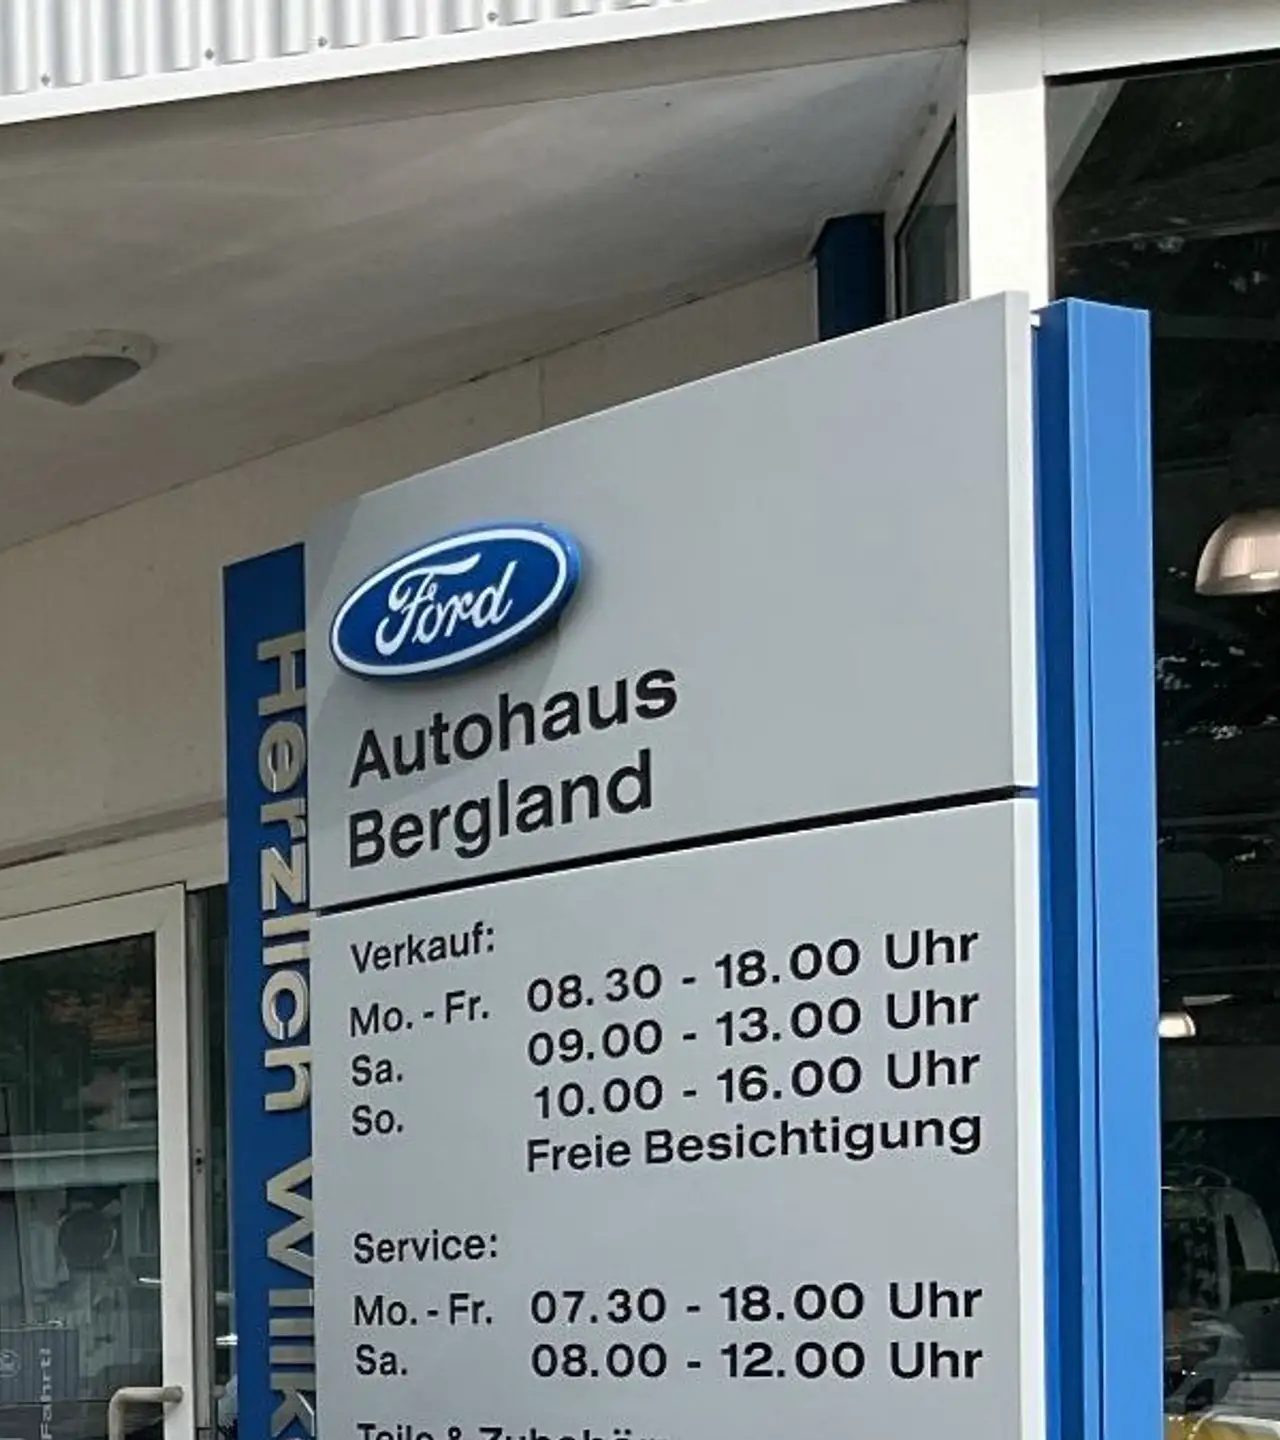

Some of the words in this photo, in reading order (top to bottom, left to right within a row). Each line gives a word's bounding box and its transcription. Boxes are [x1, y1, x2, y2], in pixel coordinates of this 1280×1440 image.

[375, 552, 518, 656] Ford
[350, 668, 678, 787] Autohaus
[350, 749, 653, 868] Bergland
[257, 631, 310, 1112] Herzlich
[350, 920, 494, 974] Verkauf:
[527, 963, 662, 1013] 08.30
[714, 938, 861, 989] 18.00
[885, 928, 979, 970] Uhr
[351, 1054, 403, 1087] Sa.
[527, 1019, 663, 1067] 09.00
[715, 996, 861, 1047] 13.00
[886, 989, 980, 1030] Uhr
[351, 1104, 404, 1137] So.
[534, 1074, 663, 1119] 10.00
[716, 1056, 862, 1104] 16.00
[887, 1049, 981, 1090] Uhr
[527, 1134, 631, 1173] Freie
[645, 1115, 981, 1165] Besichtigung
[354, 1228, 497, 1265] Service:
[531, 1287, 667, 1324] 07.30
[719, 1282, 865, 1322] 18.00
[889, 1280, 983, 1320] Uhr
[356, 1343, 408, 1376] Sa.
[531, 1342, 667, 1378] 08.00
[720, 1341, 865, 1379] 12.00
[890, 1341, 983, 1380] Uhr
